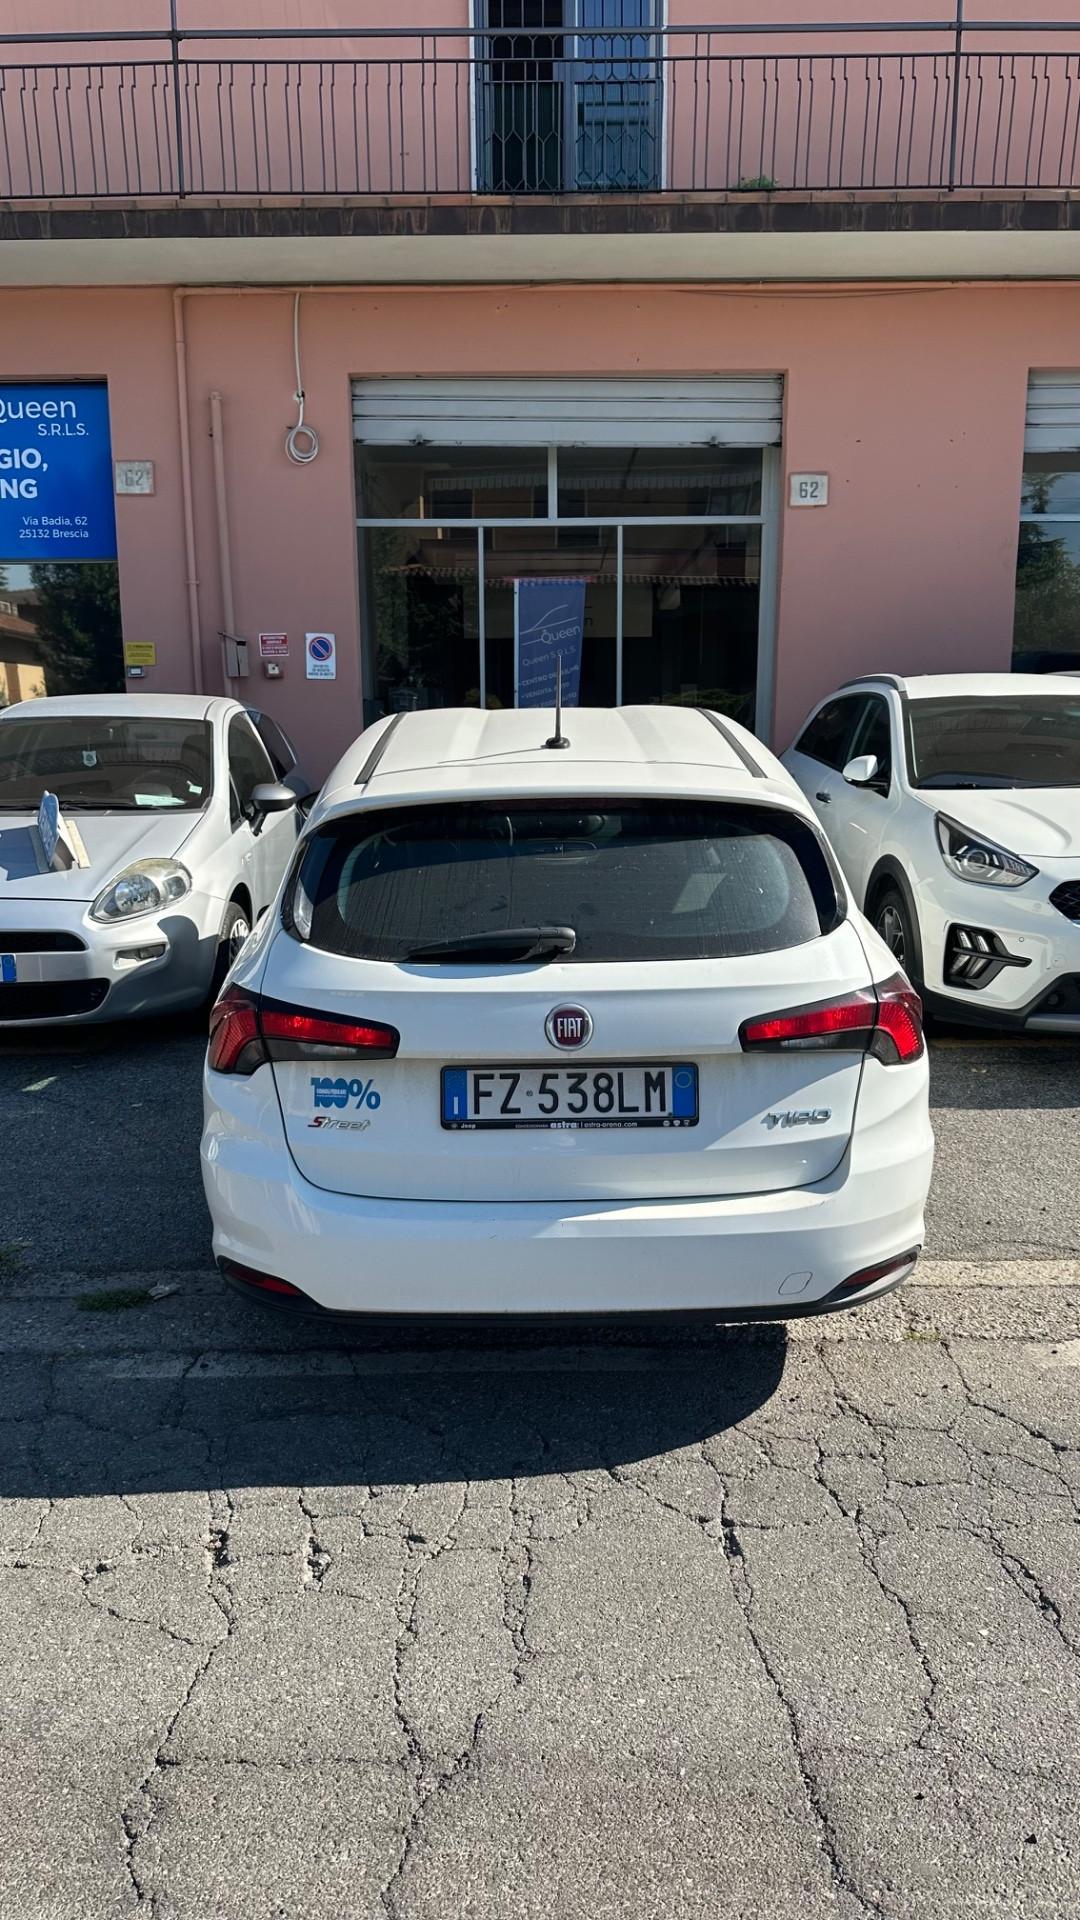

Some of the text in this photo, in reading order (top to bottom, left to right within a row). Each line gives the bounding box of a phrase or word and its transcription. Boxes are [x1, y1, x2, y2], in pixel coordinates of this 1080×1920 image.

[38, 423, 89, 436] S.R.L.S.
[125, 469, 144, 486] 62
[799, 481, 818, 498] 62
[22, 515, 88, 527] Via Badia, 62
[19, 528, 89, 538] 25132 Brescia
[541, 625, 581, 645] Queen
[557, 1017, 583, 1038] FIAT
[473, 1071, 667, 1115] FZ 538LM
[307, 1116, 372, 1131] Street
[460, 1122, 477, 1130] Jeep
